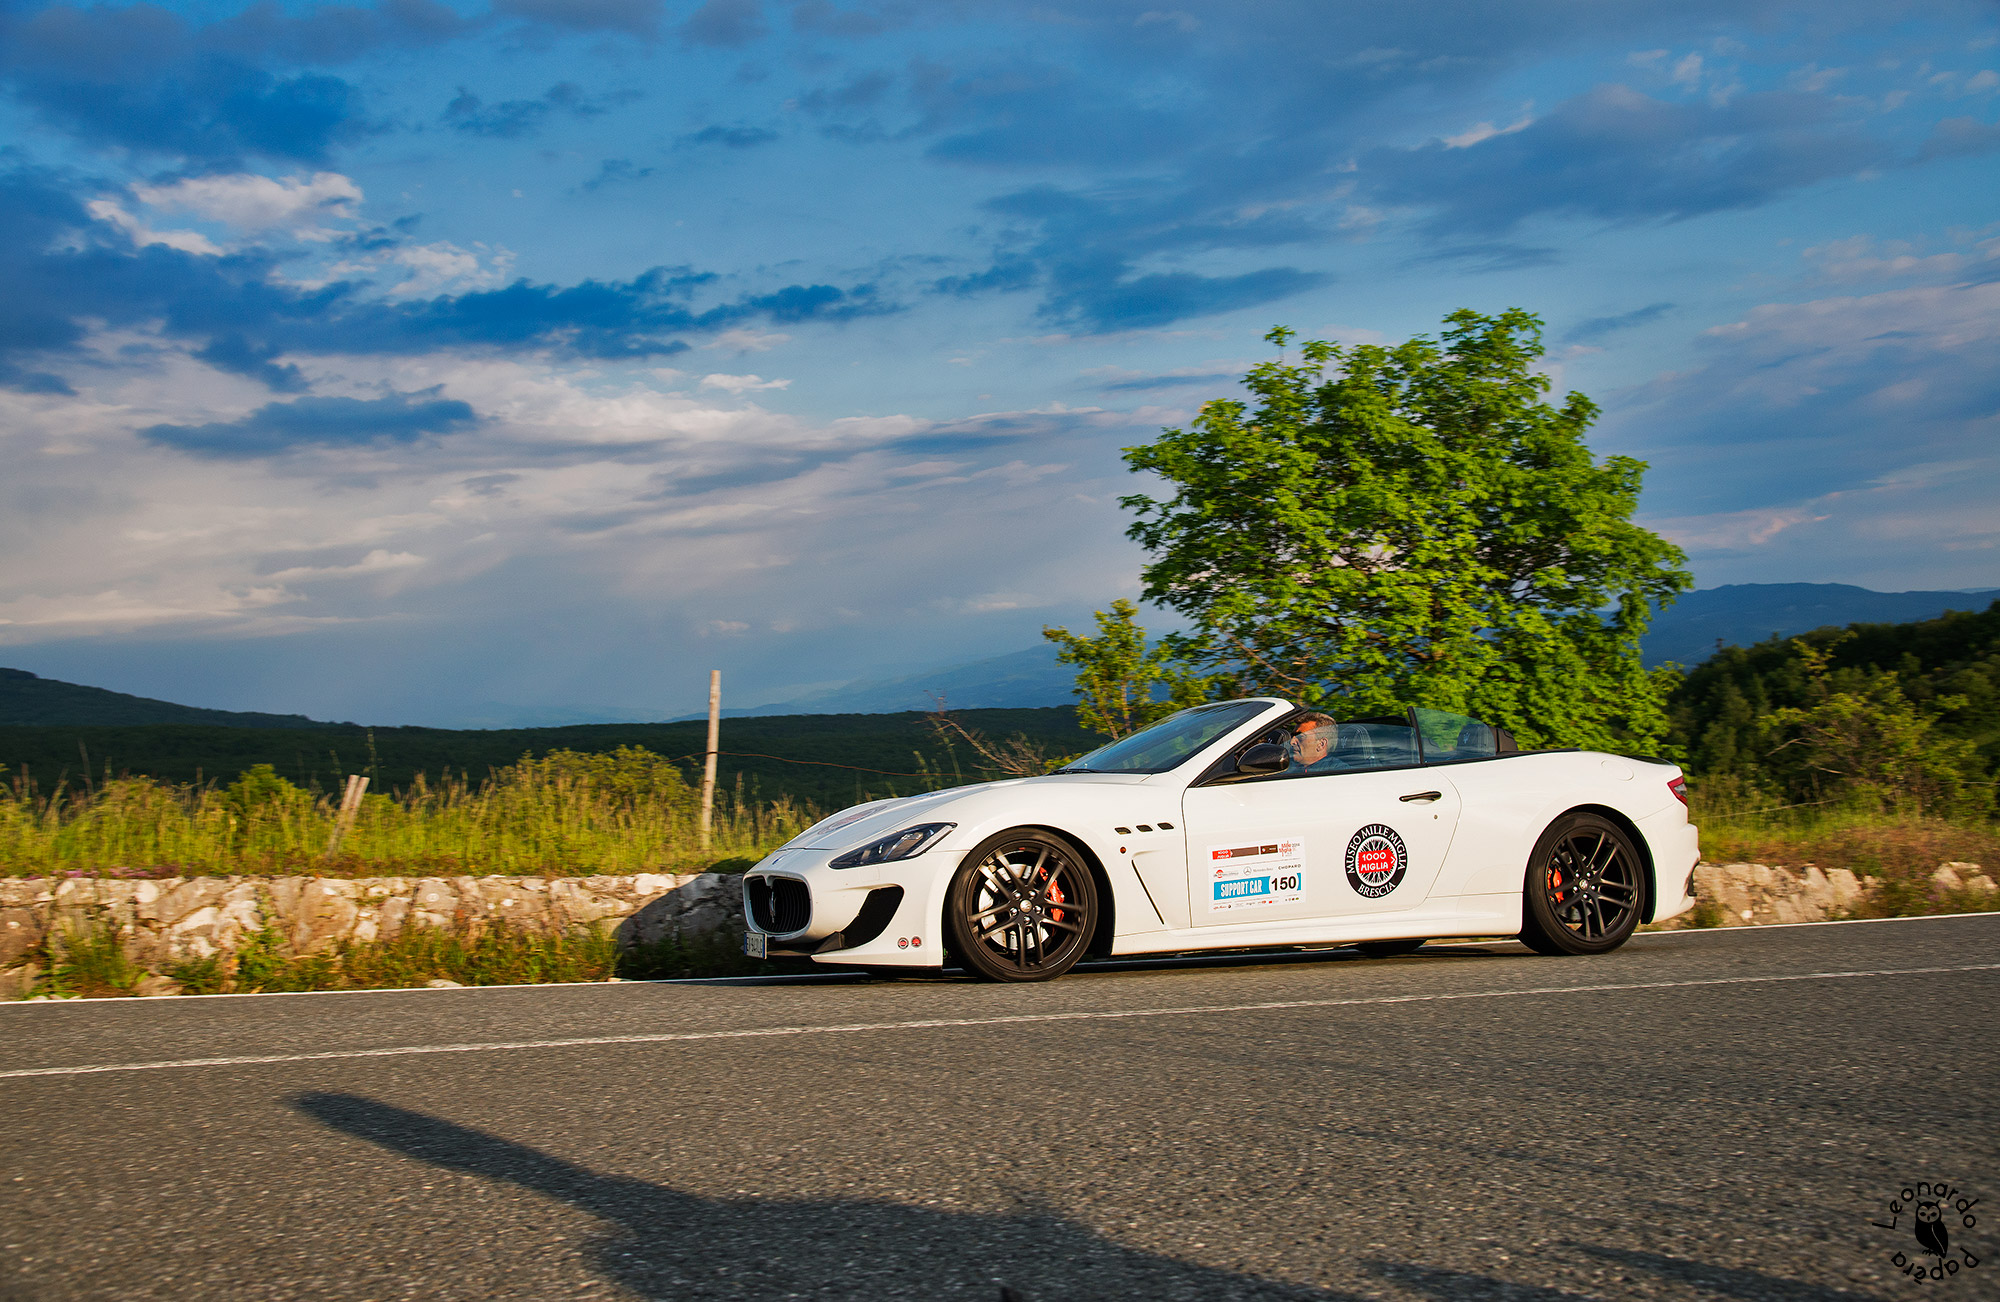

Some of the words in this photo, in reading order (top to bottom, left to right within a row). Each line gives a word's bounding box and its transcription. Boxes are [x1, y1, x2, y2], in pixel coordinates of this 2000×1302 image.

[1346, 835, 1362, 874] MUSEO
[1361, 825, 1390, 839] MILLE
[1387, 832, 1407, 870] MIGLIA
[1361, 851, 1387, 861] 1000
[1360, 861, 1389, 871] MIGLIA
[1220, 880, 1249, 897] SUPPORT
[1249, 879, 1263, 893] CAR
[1271, 875, 1297, 891] 150
[1357, 881, 1396, 898] BRESCIA
